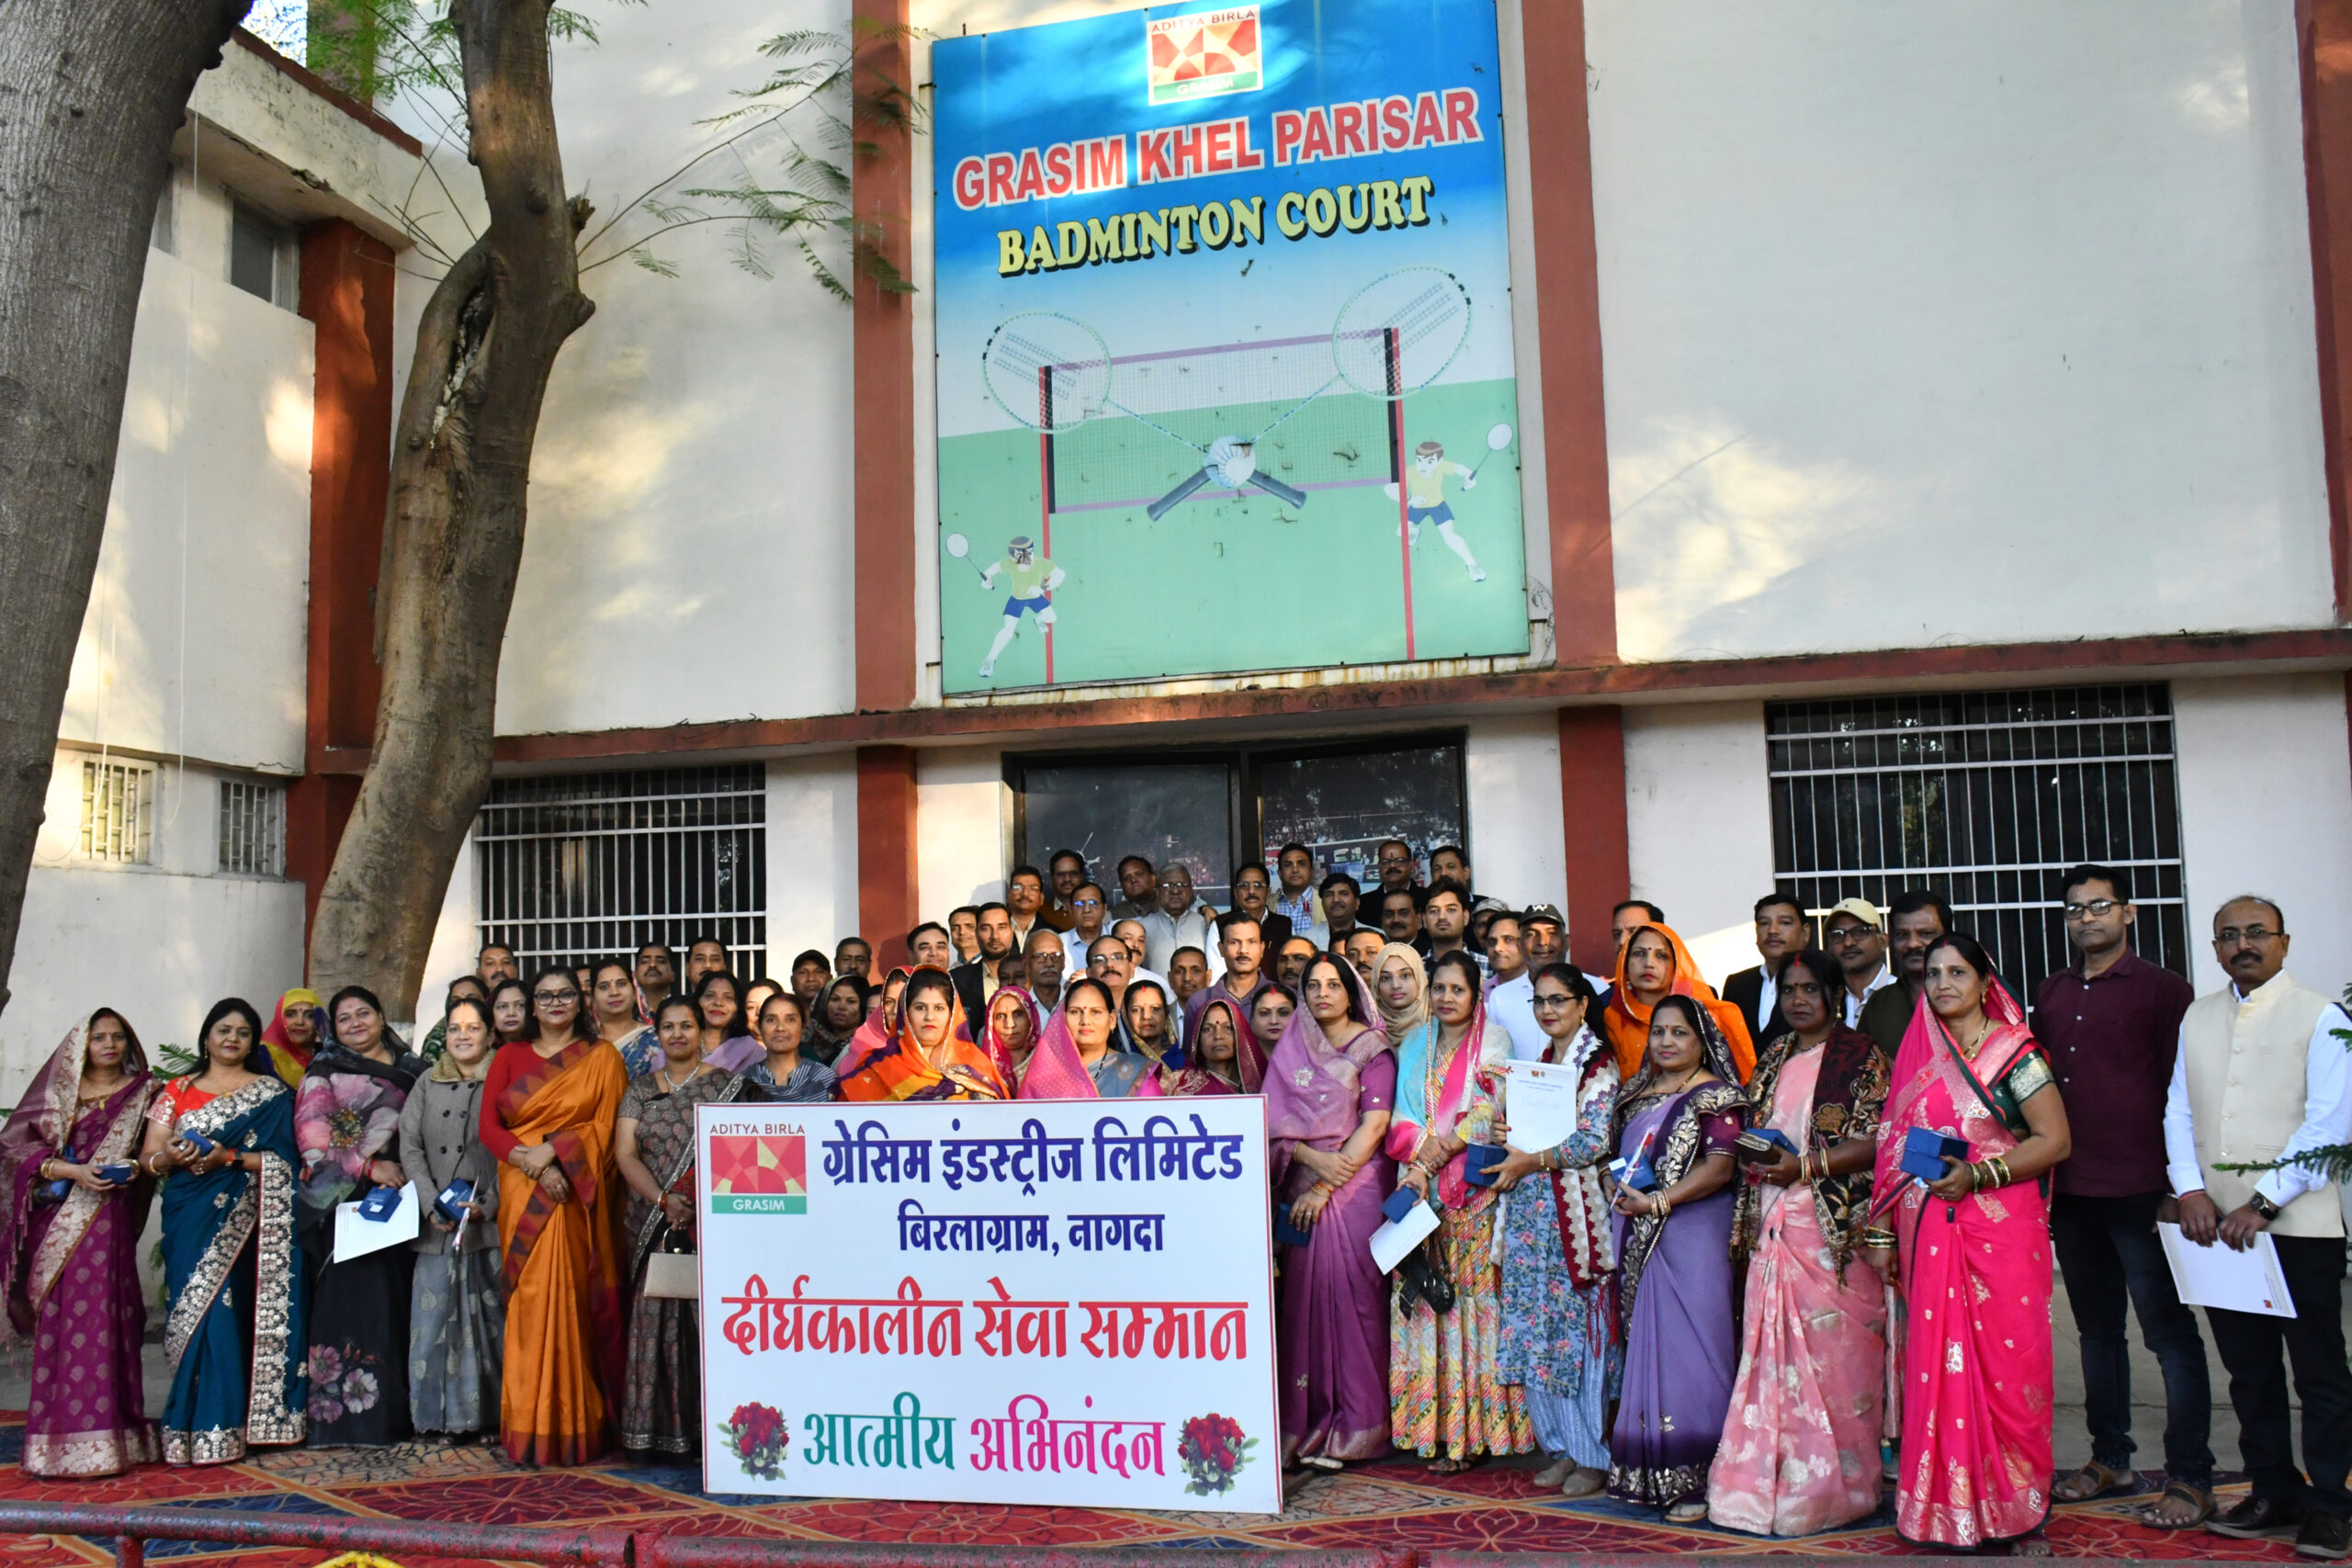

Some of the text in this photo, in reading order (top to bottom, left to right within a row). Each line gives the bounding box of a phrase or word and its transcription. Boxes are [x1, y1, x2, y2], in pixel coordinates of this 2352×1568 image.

[1151, 10, 1255, 33] ADITYA BIRLA
[954, 87, 1484, 209] GRASIM KHEL PARISAR
[997, 175, 1434, 276] BADMINTON COURT
[710, 1123, 805, 1134] ADITYA BIRLA
[822, 1114, 1243, 1196] ग्रेसिम इंडस्ट्रीज लिमिटेड
[732, 1199, 785, 1211] GRASIM
[898, 1199, 1165, 1257] बिरलाग्राम, नागदा
[722, 1274, 1248, 1360] दीर्घकालीन सेवा सम्मान
[804, 1392, 1165, 1478] आत्मीय अभिनंदन
